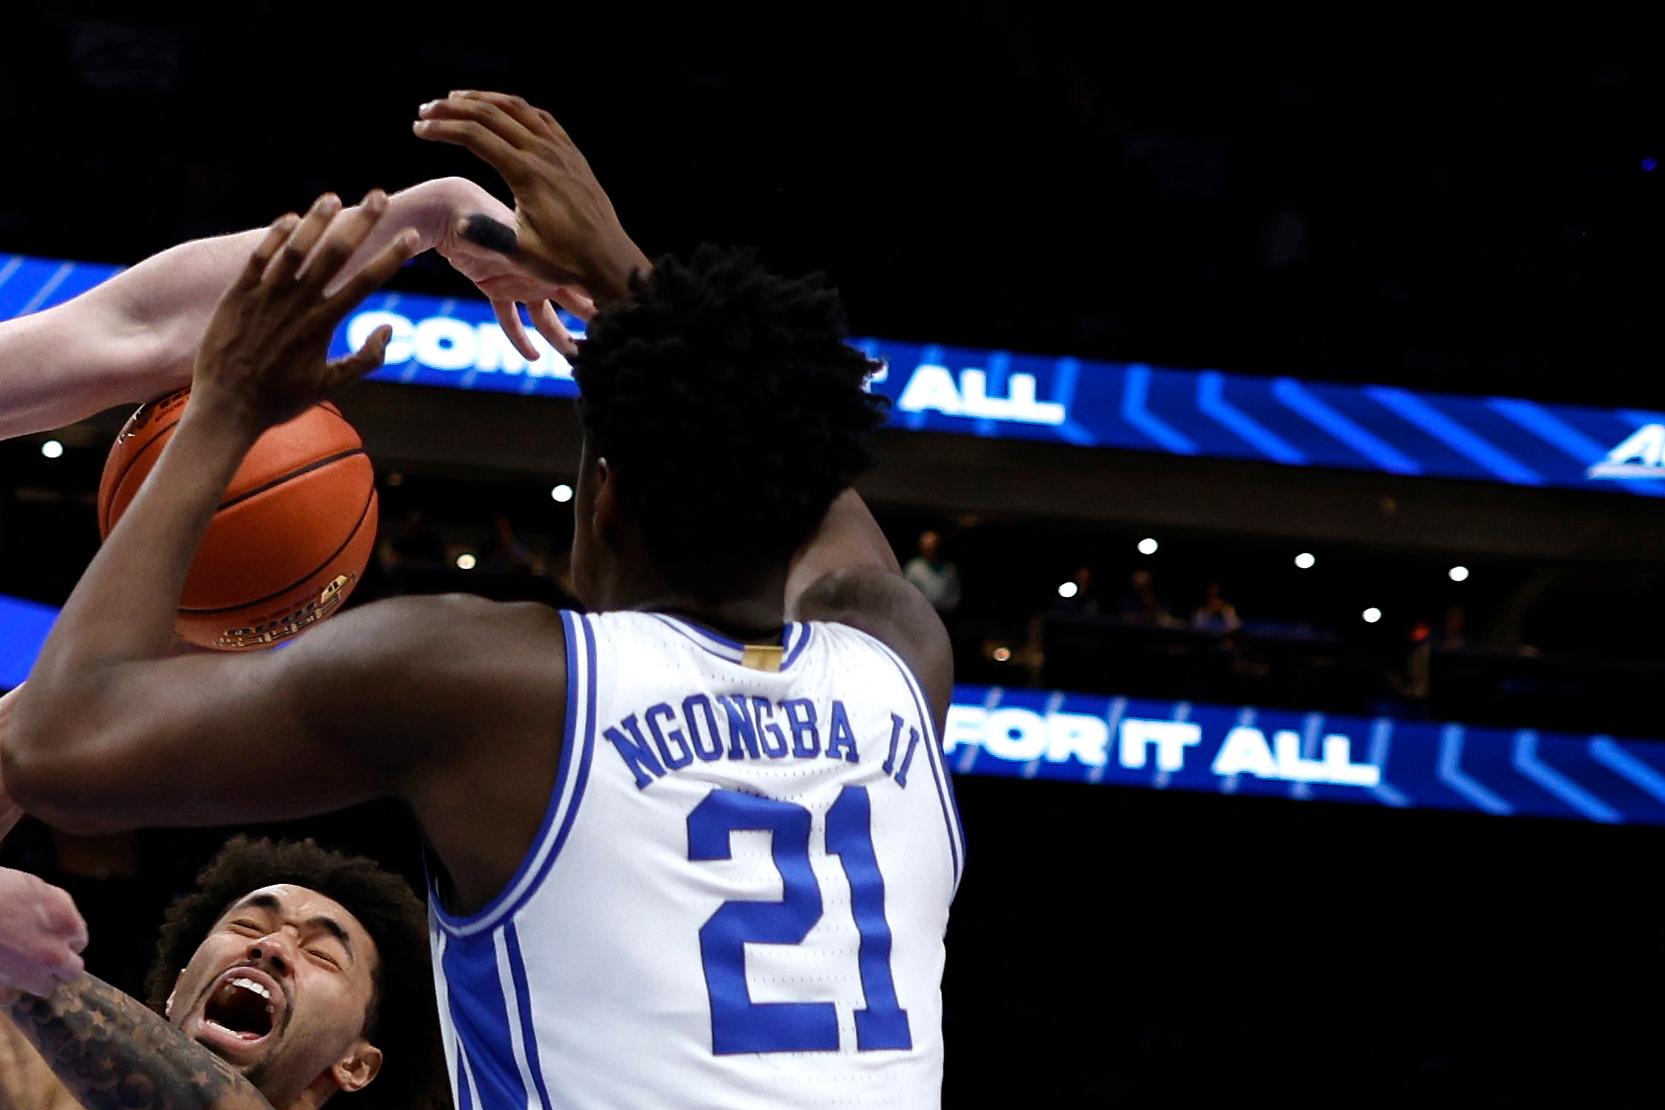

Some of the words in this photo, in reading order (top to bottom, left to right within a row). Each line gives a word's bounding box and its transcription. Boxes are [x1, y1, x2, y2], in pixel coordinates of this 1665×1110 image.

[346, 310, 577, 382] COM
[897, 364, 1066, 426] ALL
[602, 694, 860, 791] NGONGBA
[882, 713, 920, 789] II
[943, 703, 1109, 766] FOR
[1118, 718, 1202, 773] IT
[1211, 726, 1380, 787] ALL
[686, 785, 913, 1056] 21
